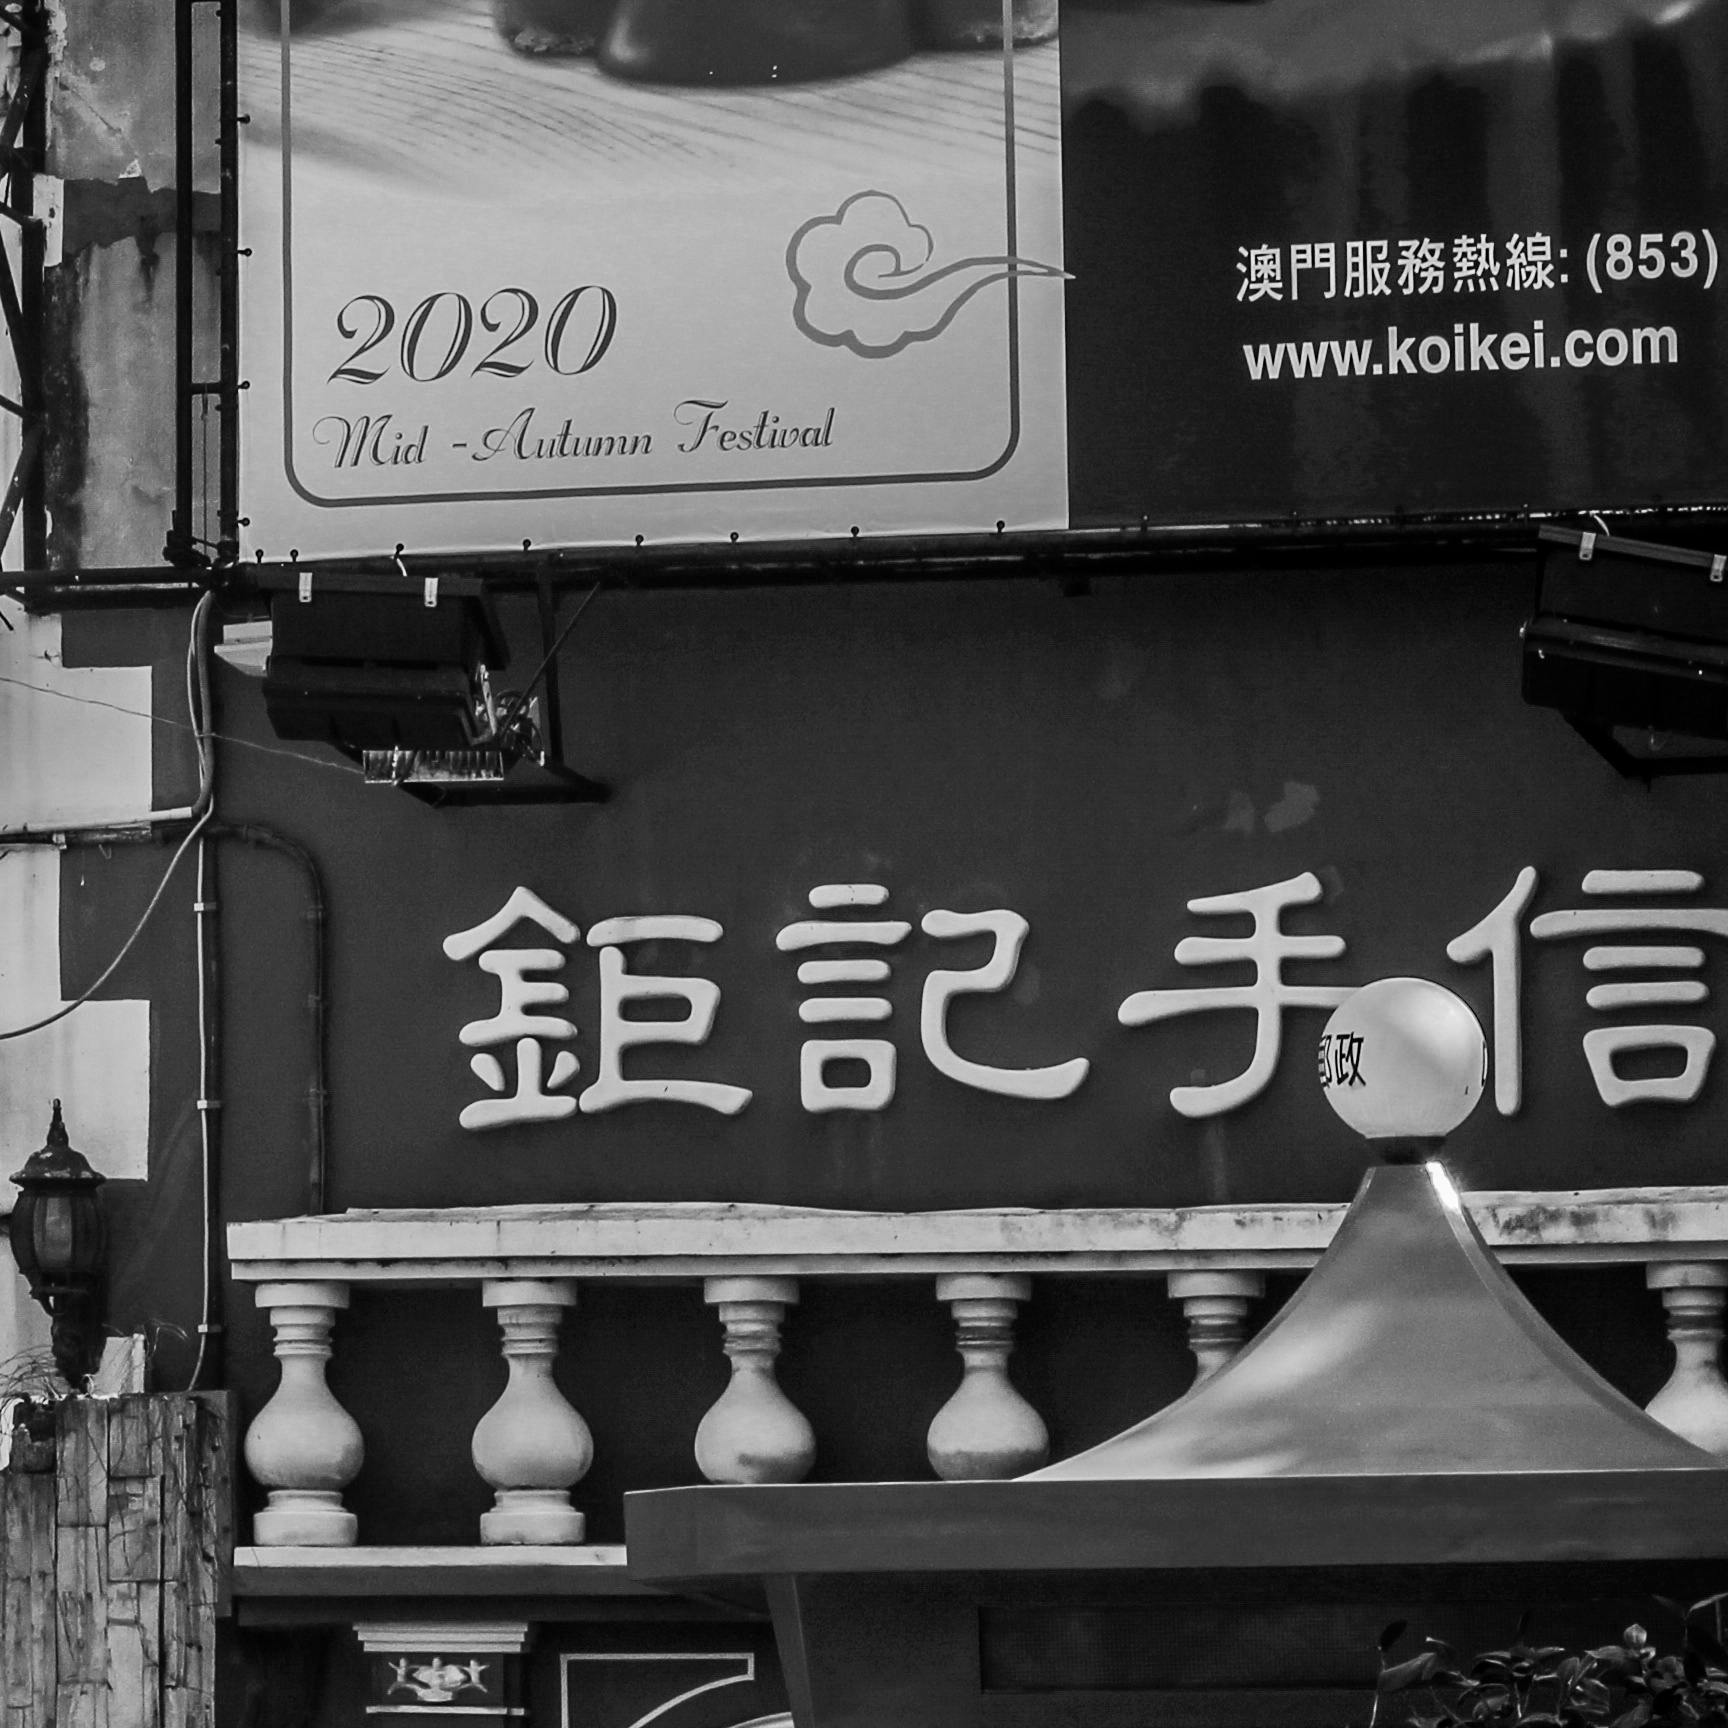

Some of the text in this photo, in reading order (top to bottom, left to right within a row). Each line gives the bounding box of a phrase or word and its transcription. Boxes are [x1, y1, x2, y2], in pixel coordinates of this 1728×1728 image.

[1586, 229, 1719, 294] (853)
[328, 284, 618, 384] 2020
[1243, 320, 1678, 380] www.koikei.com
[312, 412, 428, 469] Mid
[673, 398, 837, 456] Festival
